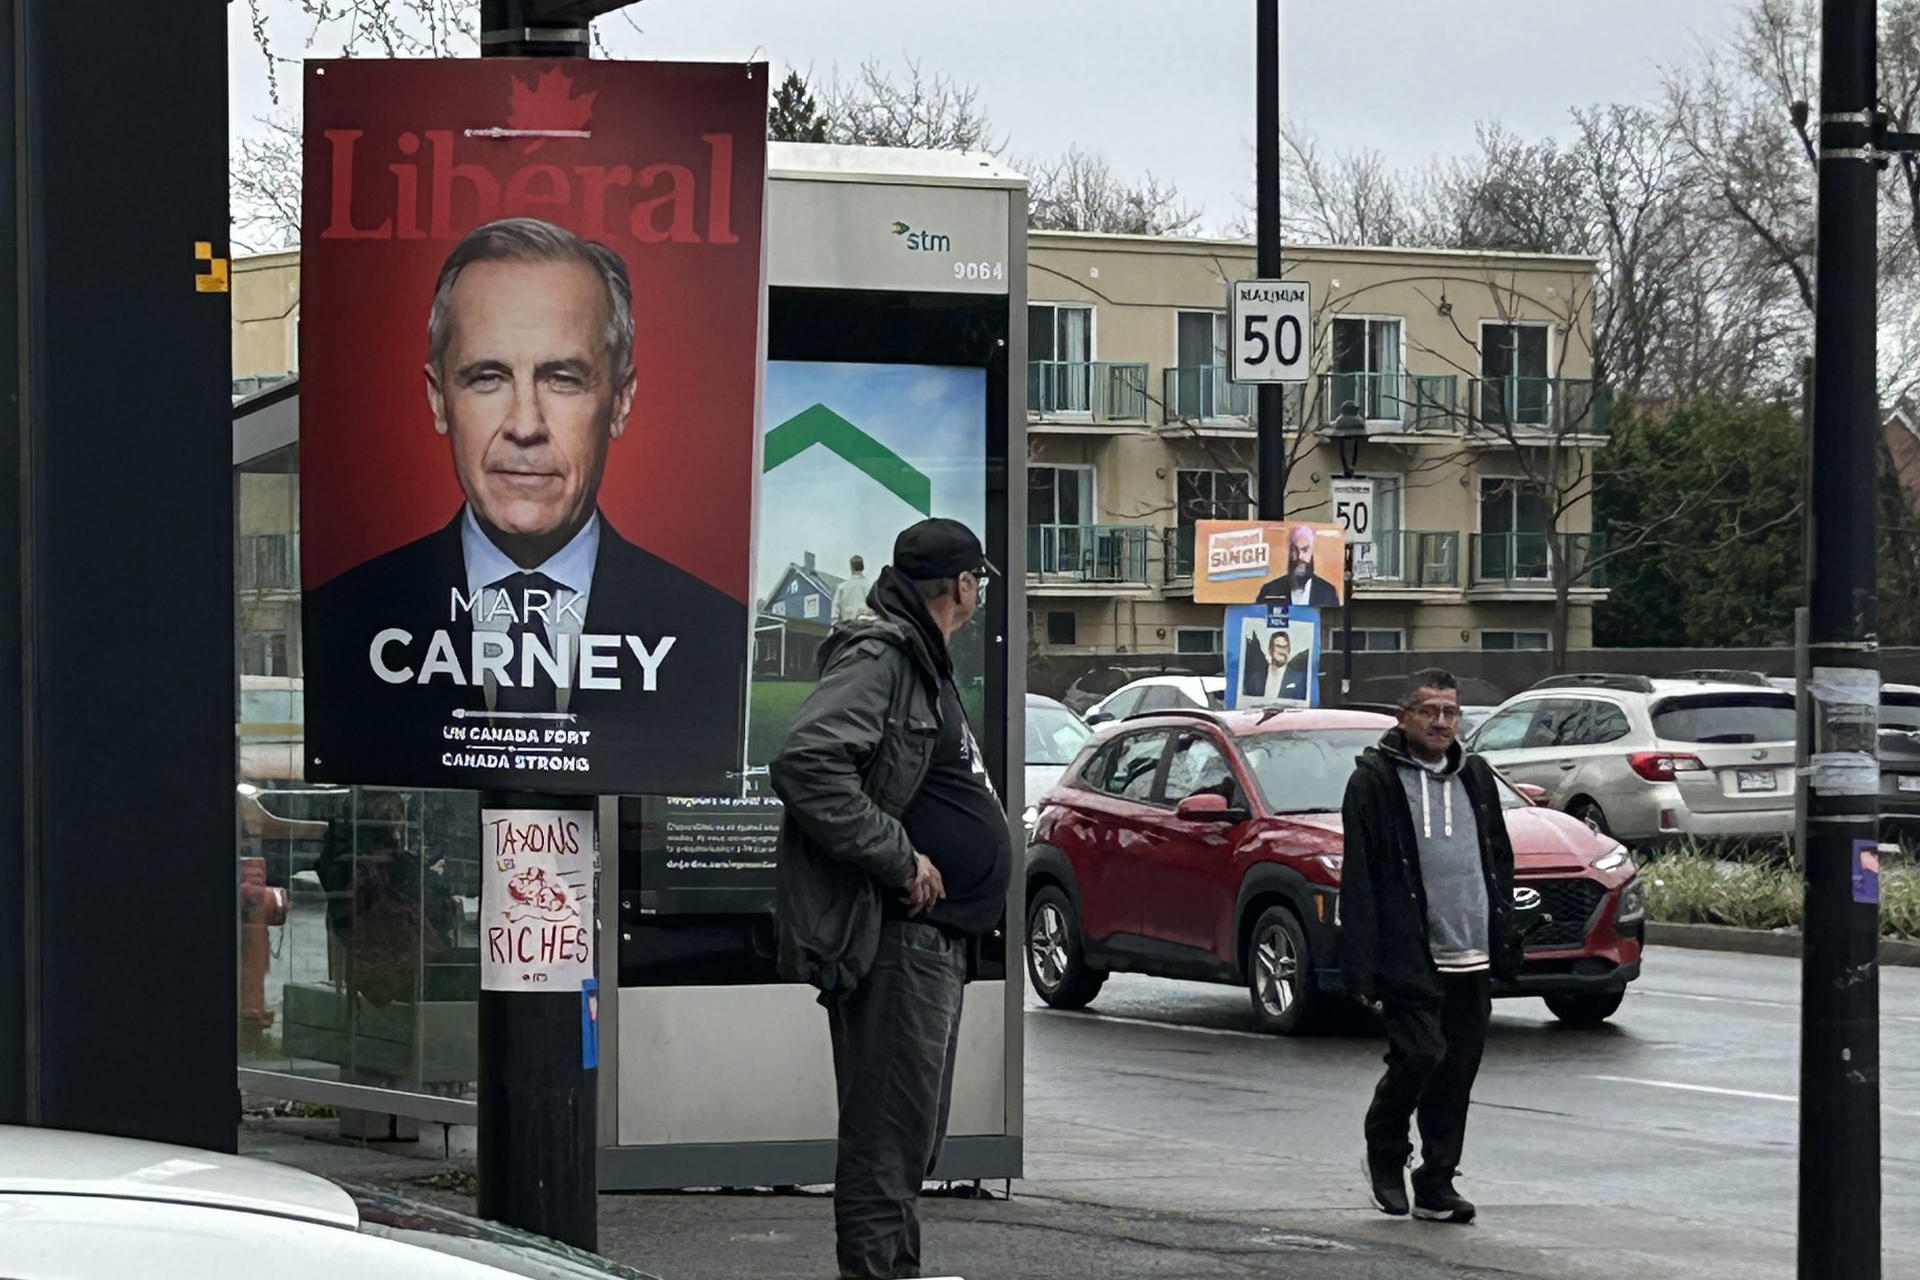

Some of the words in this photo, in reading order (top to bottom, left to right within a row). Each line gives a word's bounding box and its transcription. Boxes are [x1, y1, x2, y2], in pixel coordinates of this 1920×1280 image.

[320, 128, 740, 244] Libéral
[906, 230, 951, 252] stm
[953, 261, 1003, 280] 9064
[1243, 314, 1302, 366] 50
[1336, 502, 1368, 534] 50
[1210, 546, 1267, 568] SINGH
[450, 587, 585, 625] MARK
[369, 628, 677, 691] CARNEY
[469, 727, 539, 743] CANADA
[544, 729, 591, 745] FORT
[442, 752, 510, 769] CANADA
[515, 754, 590, 772] STRONG
[490, 817, 580, 856] TAXONS
[488, 924, 589, 964] RICHES
